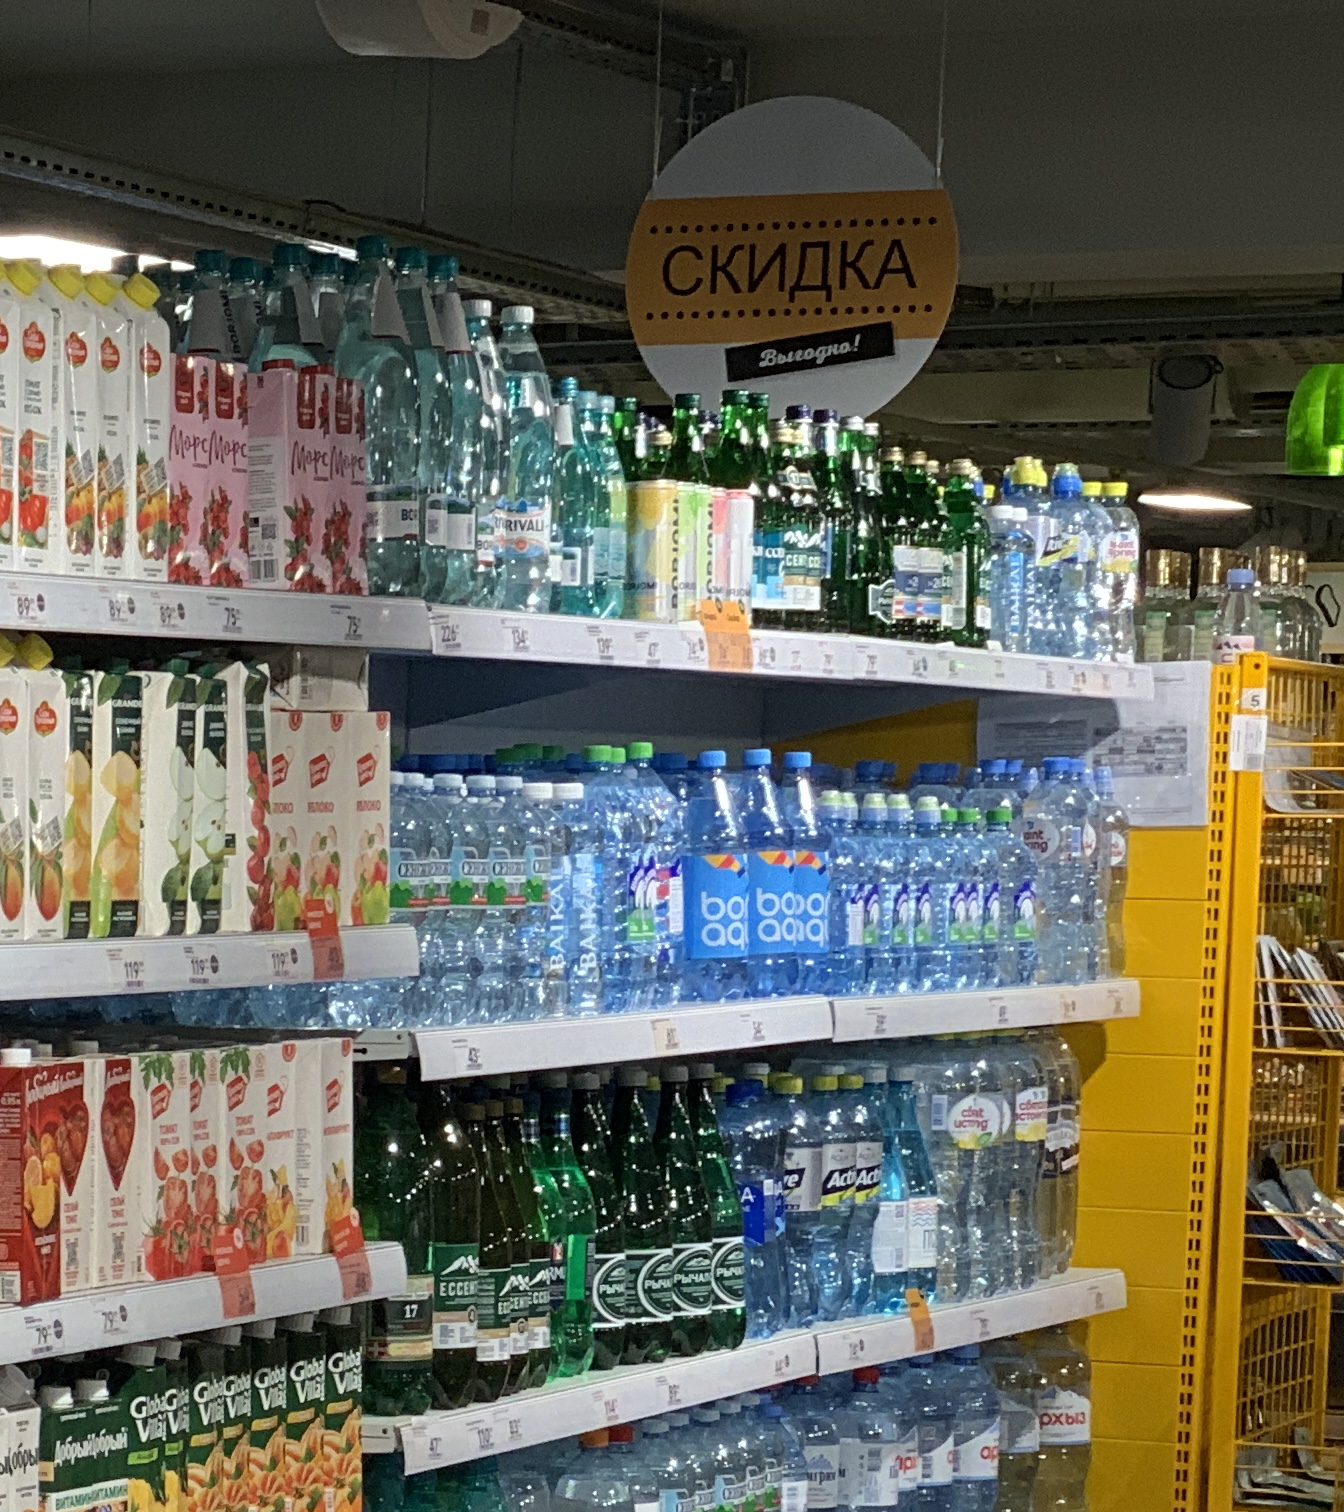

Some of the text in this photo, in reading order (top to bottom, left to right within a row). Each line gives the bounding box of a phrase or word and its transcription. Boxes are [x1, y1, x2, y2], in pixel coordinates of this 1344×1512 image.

[662, 239, 917, 303] СКИДКА
[759, 334, 861, 368] Выгодно!
[1249, 695, 1260, 709] 5
